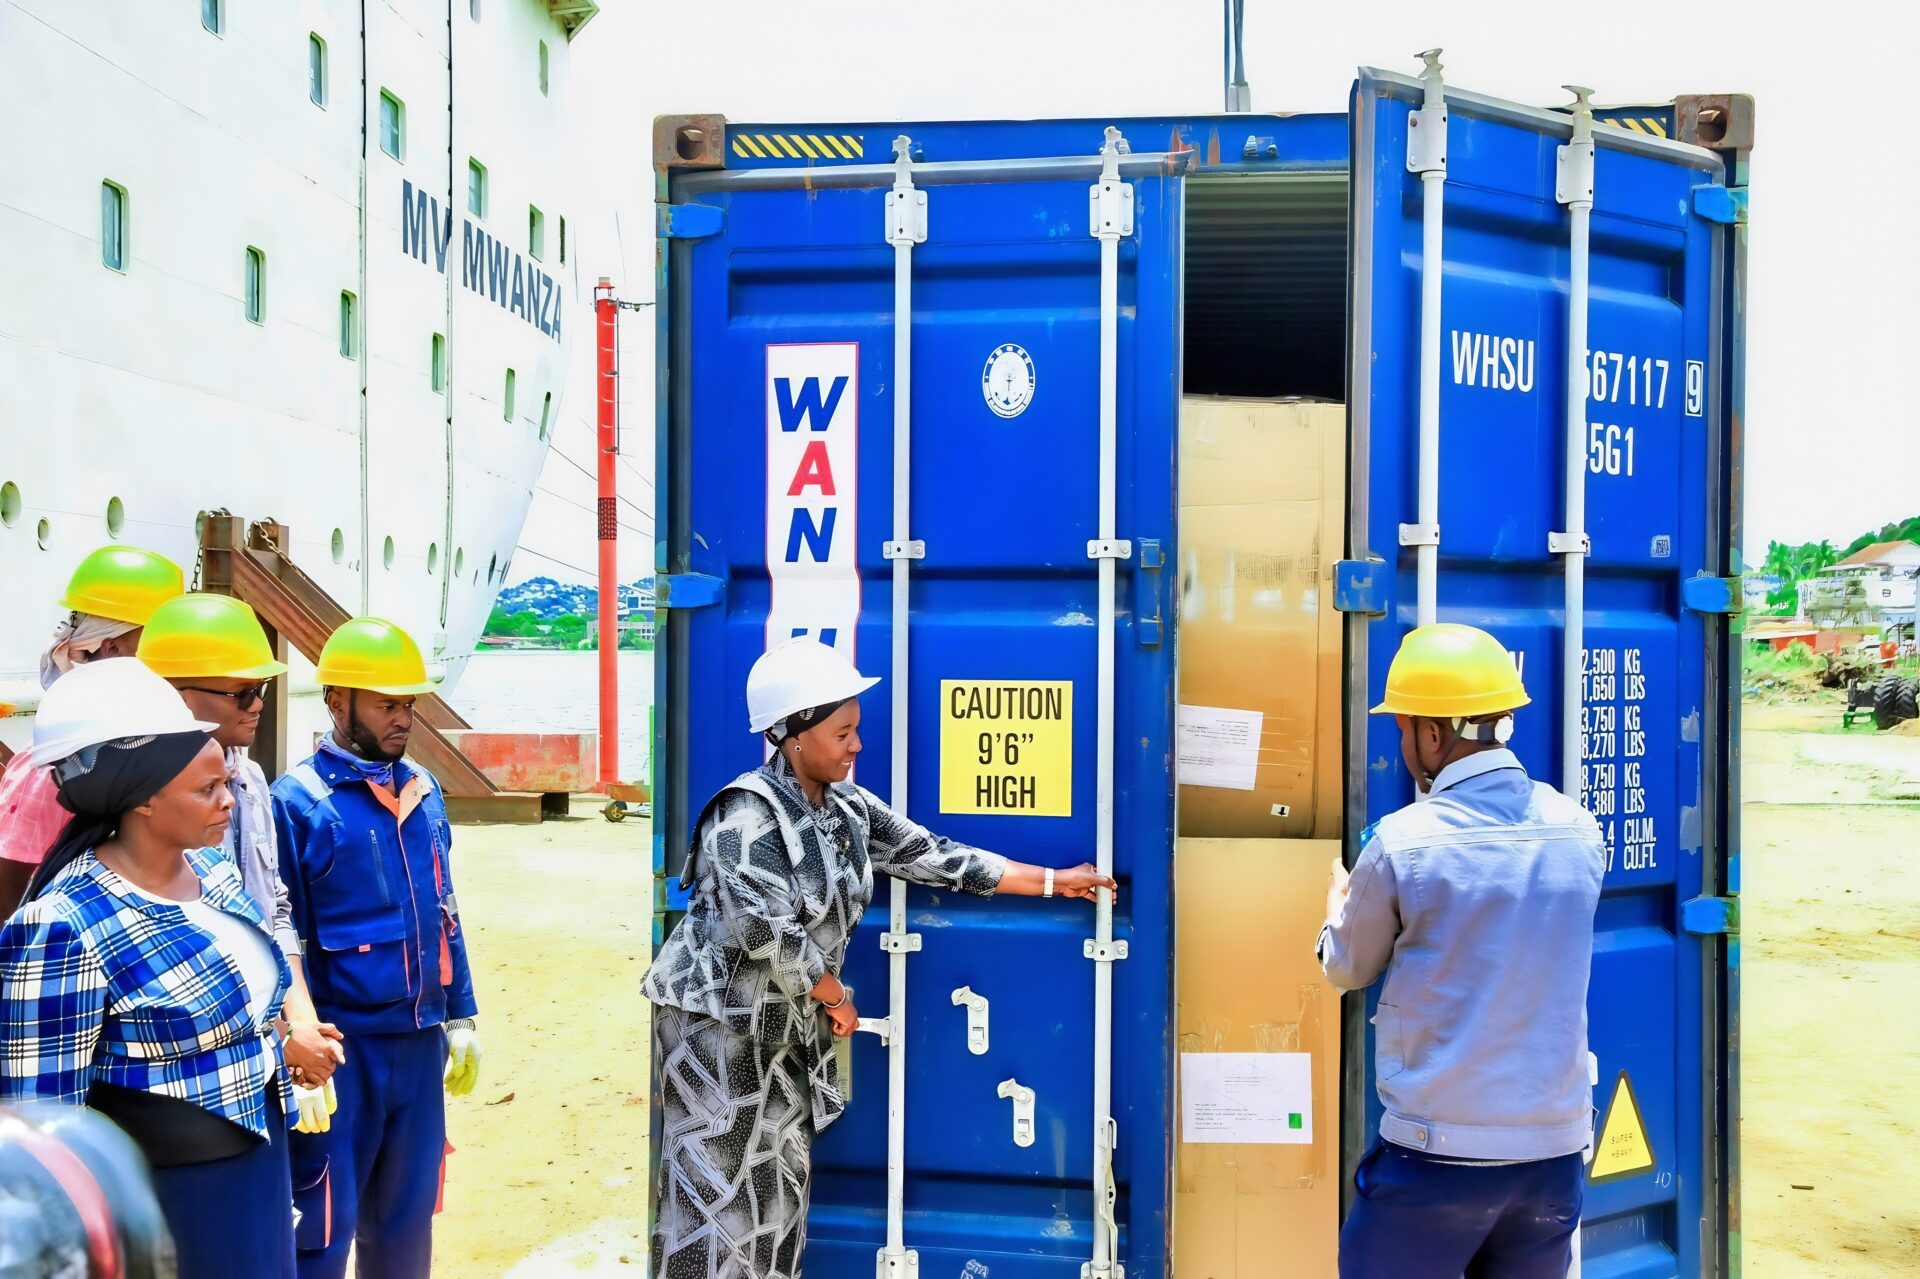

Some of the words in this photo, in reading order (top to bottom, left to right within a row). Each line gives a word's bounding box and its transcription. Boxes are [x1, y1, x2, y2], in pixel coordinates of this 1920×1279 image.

[402, 178, 452, 274] MV
[462, 218, 562, 344] MWANZA
[1451, 329, 1535, 393] WHSU
[1686, 362, 1702, 415] 9
[1584, 421, 1634, 477] 5G1
[773, 375, 850, 563] WAN
[1581, 648, 1616, 676] 2,500
[1624, 648, 1641, 674] KG
[951, 686, 1062, 720] CAUTION
[1581, 675, 1616, 703] 1,650
[1624, 674, 1646, 700] LBS
[1581, 705, 1616, 734] 3,750
[1624, 705, 1641, 731] KG
[1581, 732, 1616, 761] 8,270
[1624, 730, 1646, 757] LBS
[976, 775, 1035, 808] HIGH
[1581, 763, 1616, 792] 8,750
[1624, 762, 1641, 788] KG
[1581, 789, 1616, 816] 3380
[1624, 787, 1645, 814] LBS
[1623, 817, 1657, 844] CU.M.
[1623, 842, 1657, 870] CU.FT.
